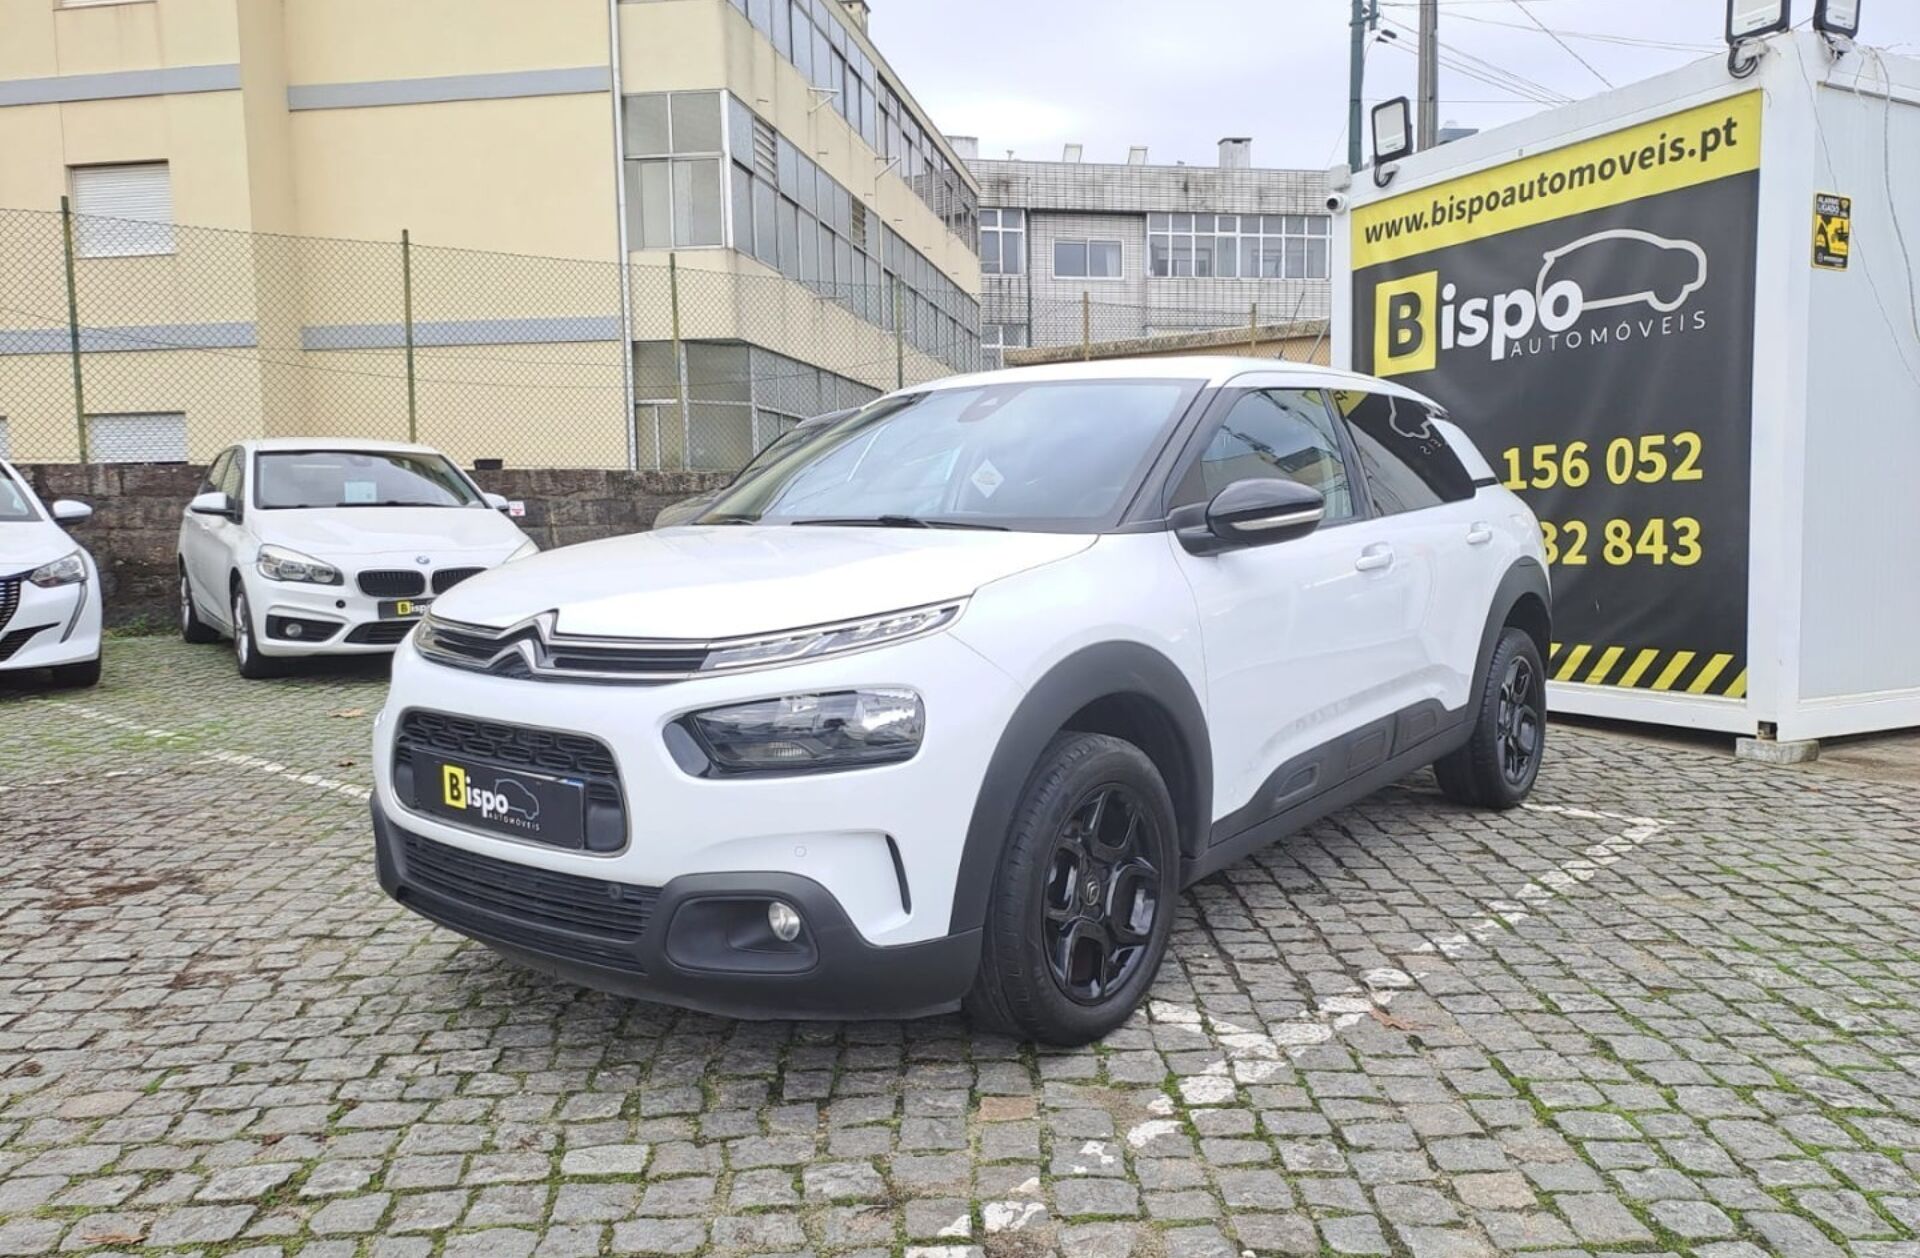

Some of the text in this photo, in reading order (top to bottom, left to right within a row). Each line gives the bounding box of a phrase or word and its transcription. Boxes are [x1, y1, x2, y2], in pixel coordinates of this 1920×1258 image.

[1364, 116, 1738, 244] www.bispoautomoveis.pt
[1388, 279, 1584, 361] Bispo
[1511, 310, 1707, 359] AUTOMÓVEIS
[1503, 431, 1704, 490] 156 052
[1603, 517, 1702, 566] 843
[449, 772, 509, 818] Bispo
